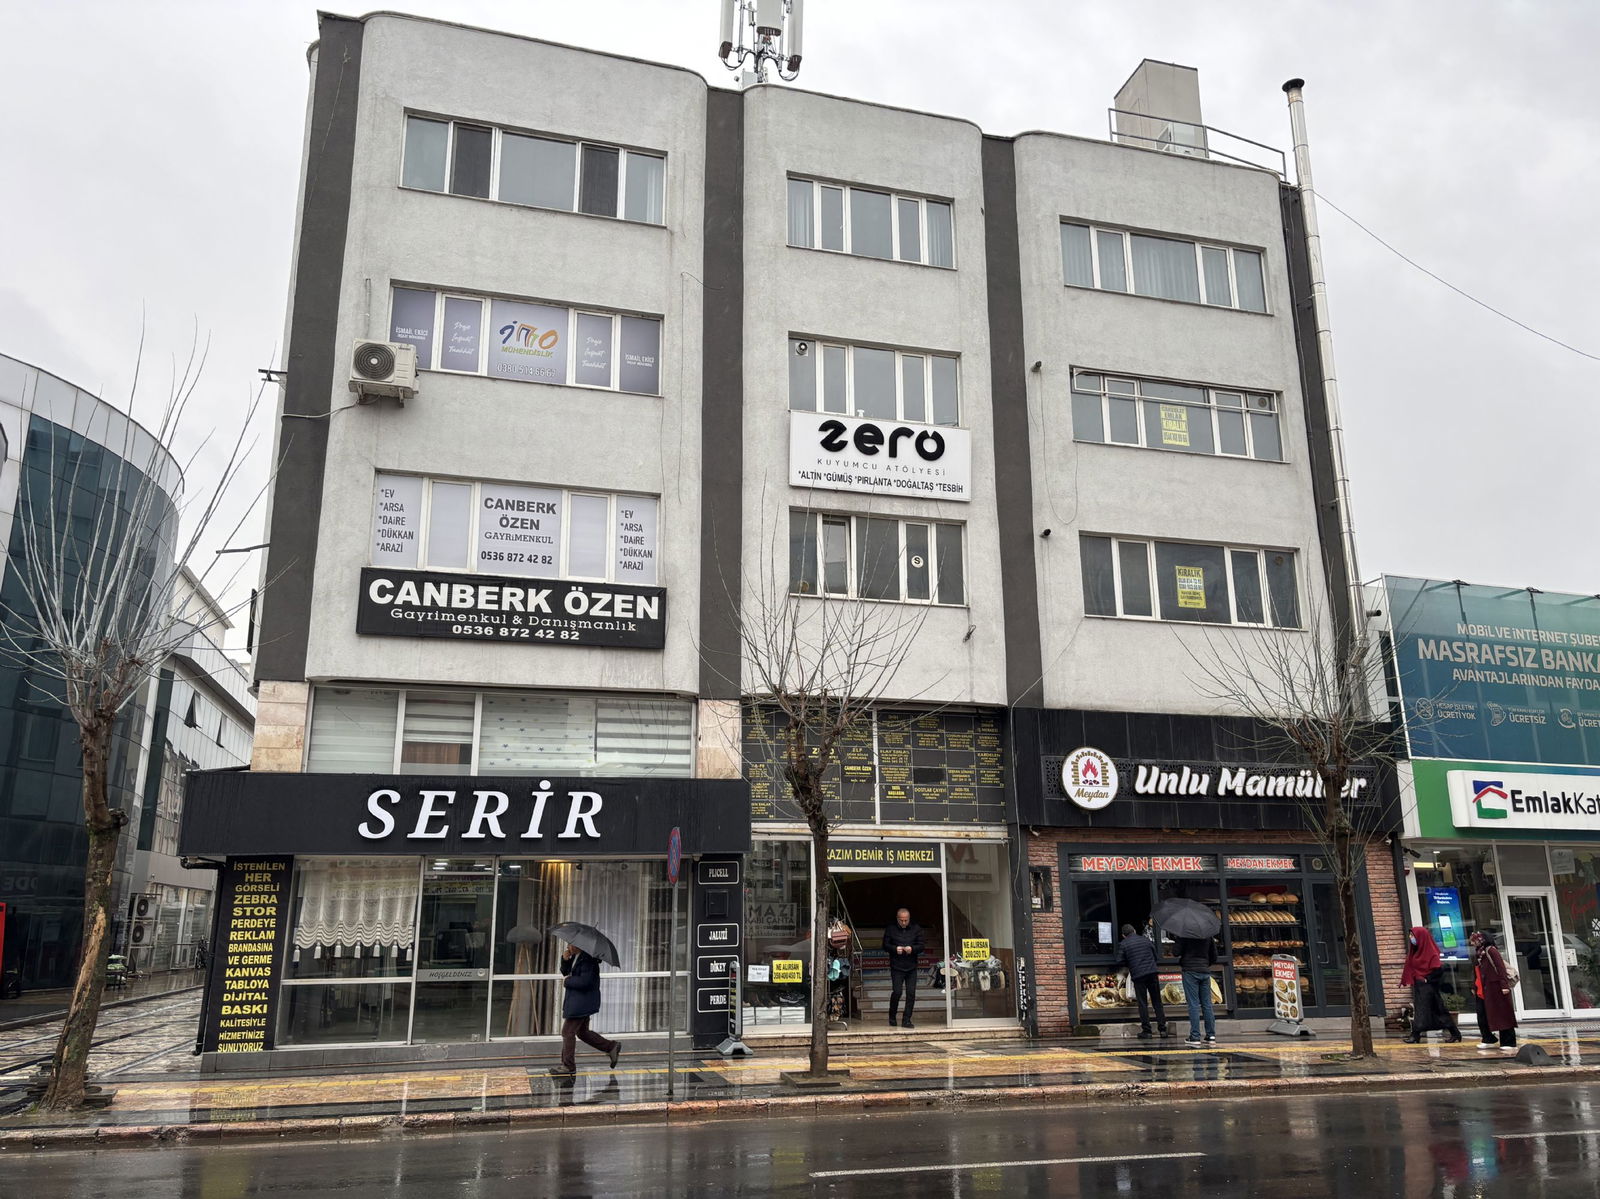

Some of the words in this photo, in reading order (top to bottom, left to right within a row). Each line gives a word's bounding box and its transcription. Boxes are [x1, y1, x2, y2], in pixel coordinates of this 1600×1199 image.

[818, 419, 945, 462] zero
[817, 458, 878, 470] KUYUMCU
[886, 464, 946, 476] ATÖLYESİ
[484, 497, 557, 515] CANBERK
[499, 513, 540, 531] ÖZEN
[481, 550, 504, 562] 0536
[507, 552, 524, 563] 872
[527, 554, 539, 564] 42
[541, 555, 553, 565] 82
[368, 578, 553, 613] CANBERK
[564, 586, 659, 620] ÖZEN
[390, 608, 506, 624] Gayrimenkul
[512, 614, 522, 625] &
[528, 616, 637, 631] Danışmanlık
[452, 625, 494, 636] 0536
[499, 627, 530, 638] 872
[534, 629, 555, 639] 42
[560, 630, 580, 641] 82
[1495, 626, 1511, 639] VE
[1417, 637, 1539, 669] MASRAFSIZ
[1452, 668, 1564, 689] AVANTAJLARINDAN
[1462, 711, 1477, 721] YOK
[1509, 711, 1547, 725] ÜCRETSİZ
[1134, 765, 1210, 795] Unlu
[1074, 788, 1109, 802] Meydan
[358, 779, 603, 839] SERİR
[855, 847, 883, 861] DEMİR
[887, 849, 894, 864] İŞ
[897, 848, 934, 862] MERKEZİ
[233, 861, 286, 871] İSTENİLEN
[1081, 856, 1148, 871] MEYDAN
[1151, 856, 1203, 871] EKMEK
[1227, 858, 1264, 869] MEYDAN
[1265, 858, 1295, 869] EKMEK
[244, 872, 272, 882] HER
[235, 882, 280, 892] GÖRSELİ
[233, 894, 278, 904] ZEBRA
[232, 906, 277, 916] STOR
[231, 918, 276, 928] PERDEYE
[229, 930, 275, 940] REKLAM
[228, 942, 273, 953] BRANDASINA
[228, 955, 239, 965] VE
[241, 955, 273, 964] GERME
[225, 967, 271, 977] KANVAS
[225, 979, 269, 990] TABLOYA
[223, 991, 268, 1001] DİJİTAL
[709, 994, 727, 1005] PERDE
[221, 1004, 268, 1015] BASKI
[219, 1017, 267, 1028] KALİTESİYLE
[218, 1030, 265, 1041] HİZMETİNİZE
[217, 1042, 264, 1053] SUNUYORUZ
